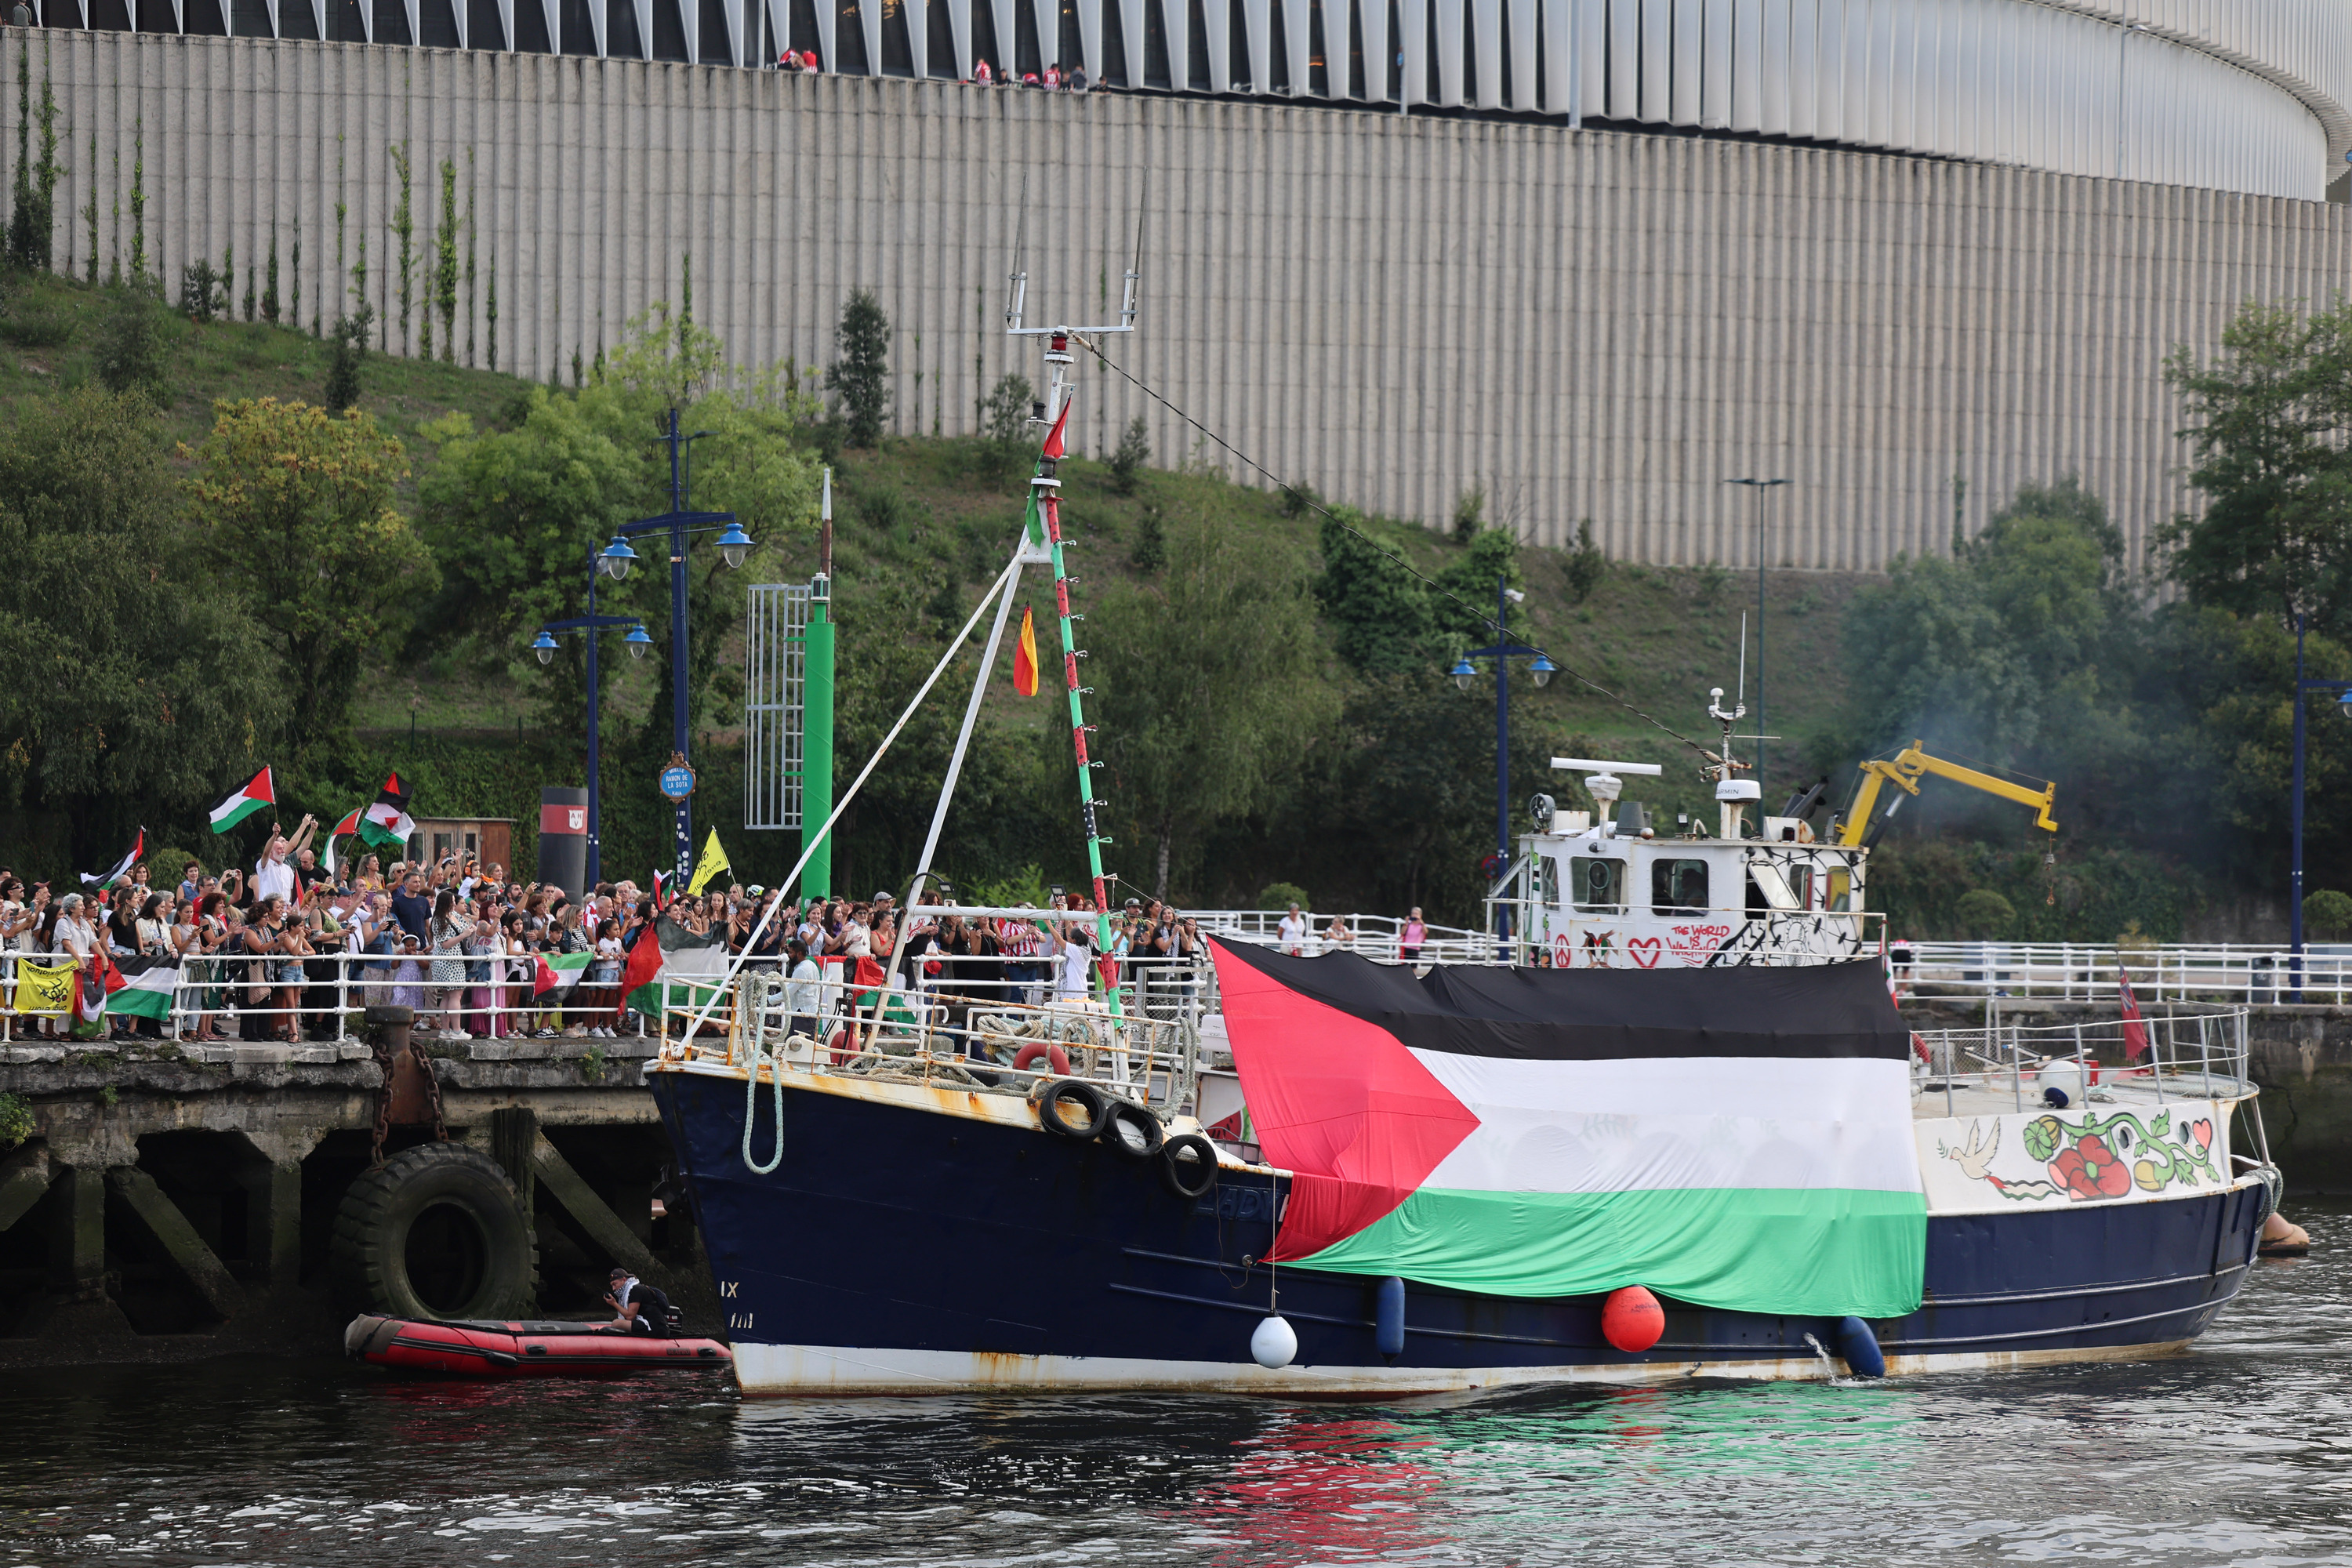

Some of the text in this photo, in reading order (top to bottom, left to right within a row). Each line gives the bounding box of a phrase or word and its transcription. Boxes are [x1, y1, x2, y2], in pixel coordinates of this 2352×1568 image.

[1671, 925, 1730, 938] THE WORLD
[1666, 937, 1719, 960] WATCHING
[1690, 935, 1700, 947] IS
[720, 1281, 739, 1298] IX
